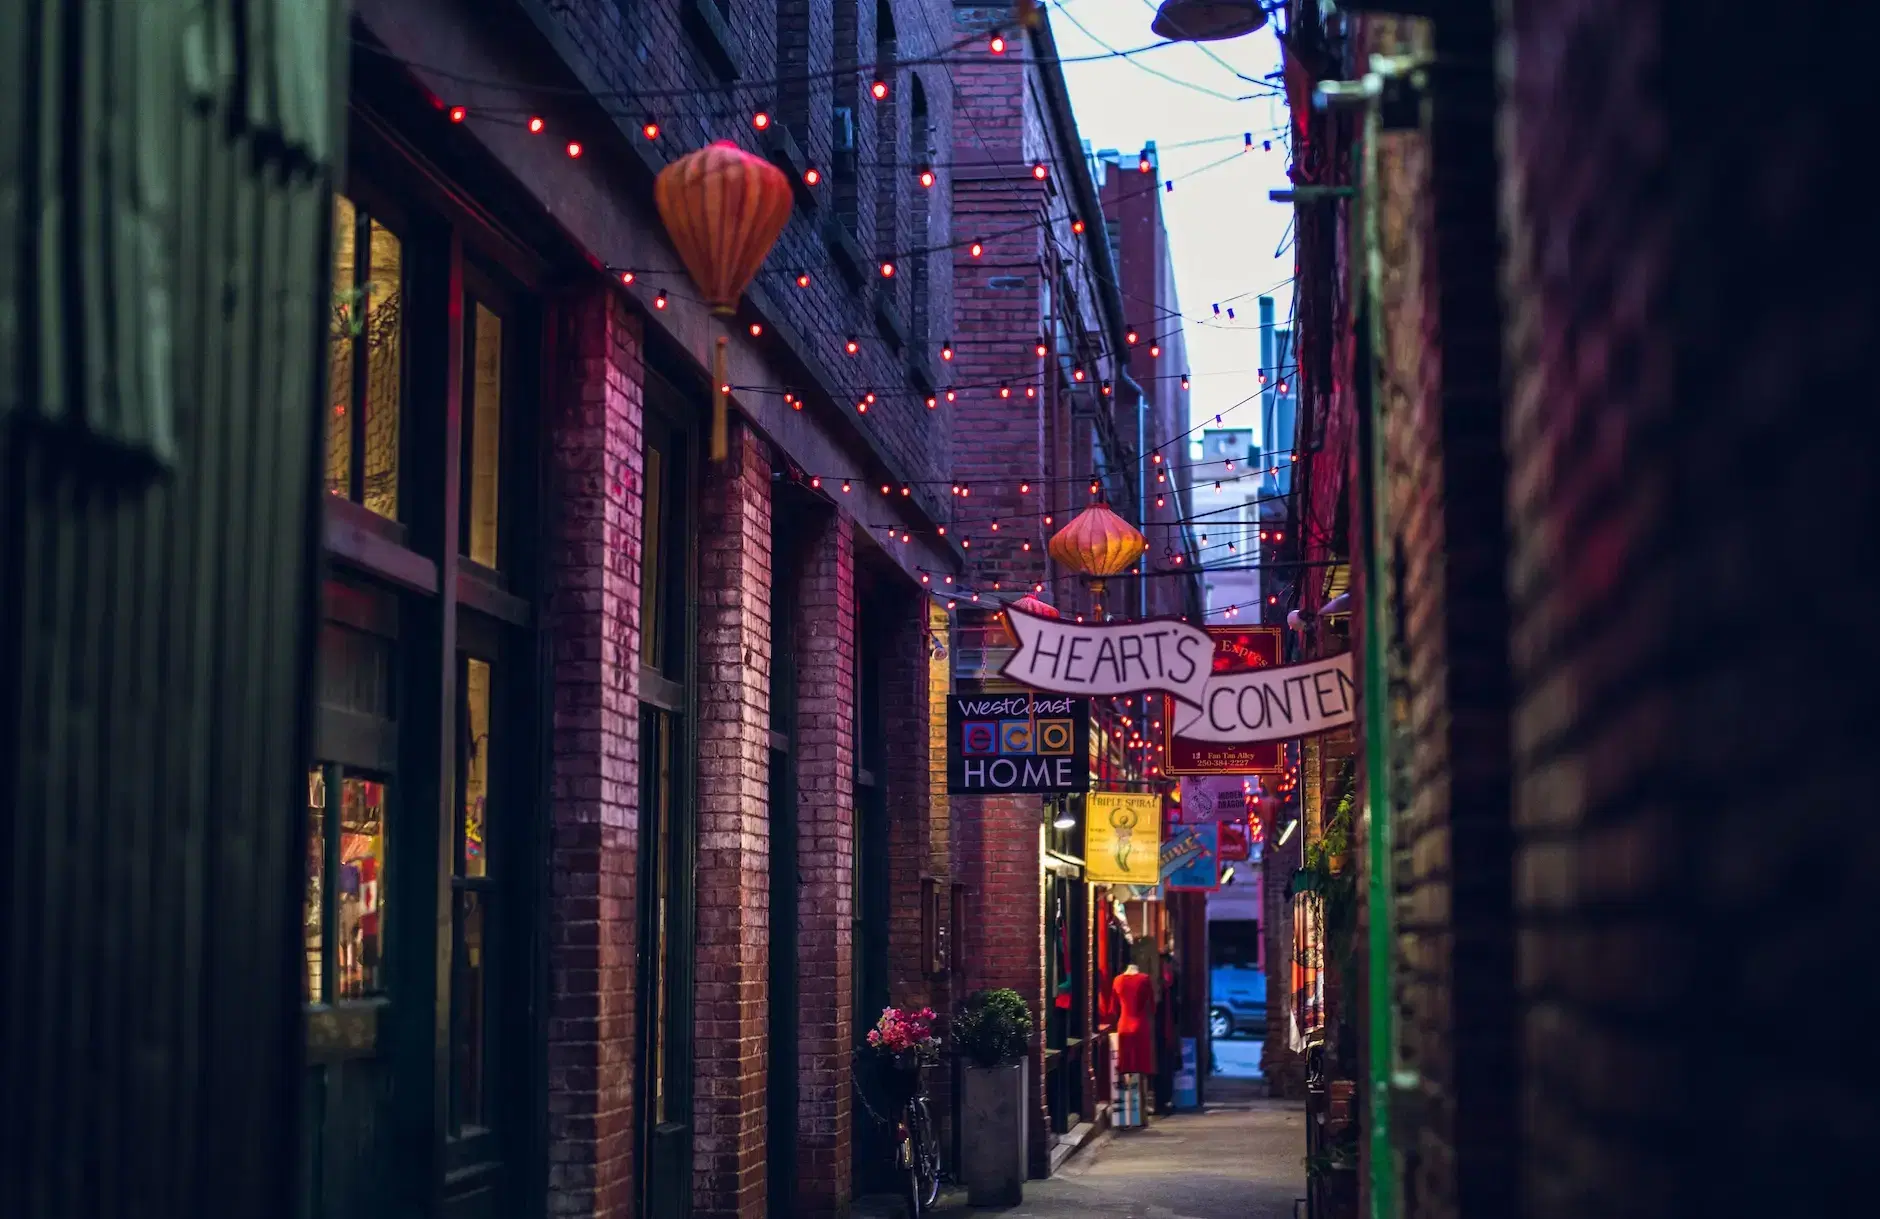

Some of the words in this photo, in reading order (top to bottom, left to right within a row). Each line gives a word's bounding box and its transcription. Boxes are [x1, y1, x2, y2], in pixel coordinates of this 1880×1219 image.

[1029, 629, 1200, 684] HEART'S
[968, 724, 1067, 749] eco
[964, 758, 1072, 788] HOME
[1218, 790, 1243, 800] HIDDEN
[1218, 800, 1244, 809] DRAGON
